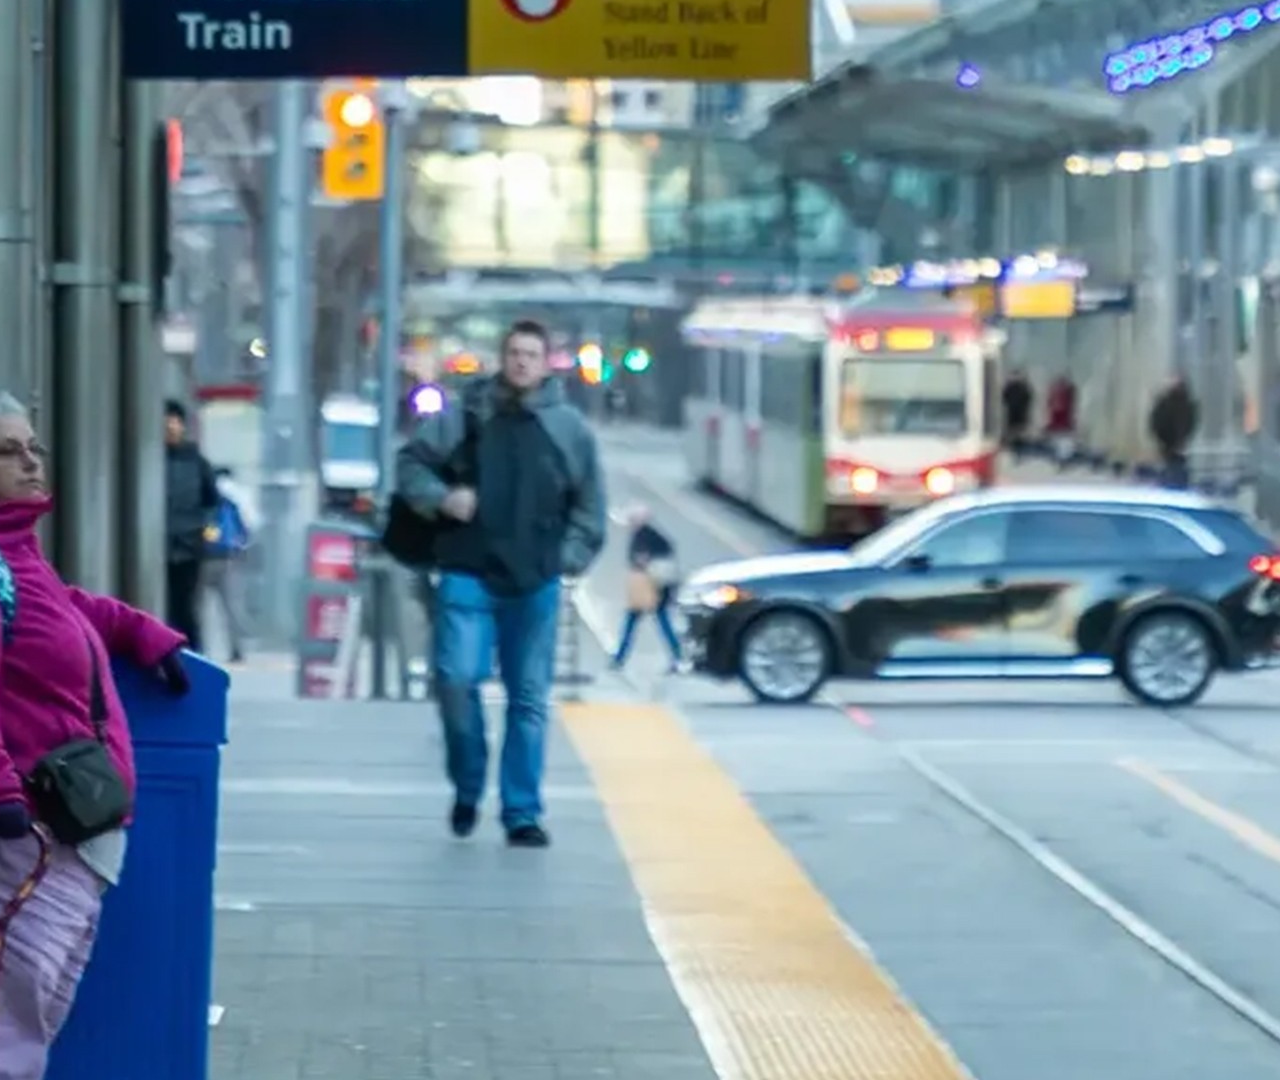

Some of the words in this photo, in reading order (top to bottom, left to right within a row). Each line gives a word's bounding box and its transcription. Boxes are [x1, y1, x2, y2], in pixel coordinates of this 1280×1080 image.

[604, 1, 668, 23] Stand
[679, 1, 737, 23] Back
[179, 12, 291, 50] Train
[603, 36, 678, 60] Yellow
